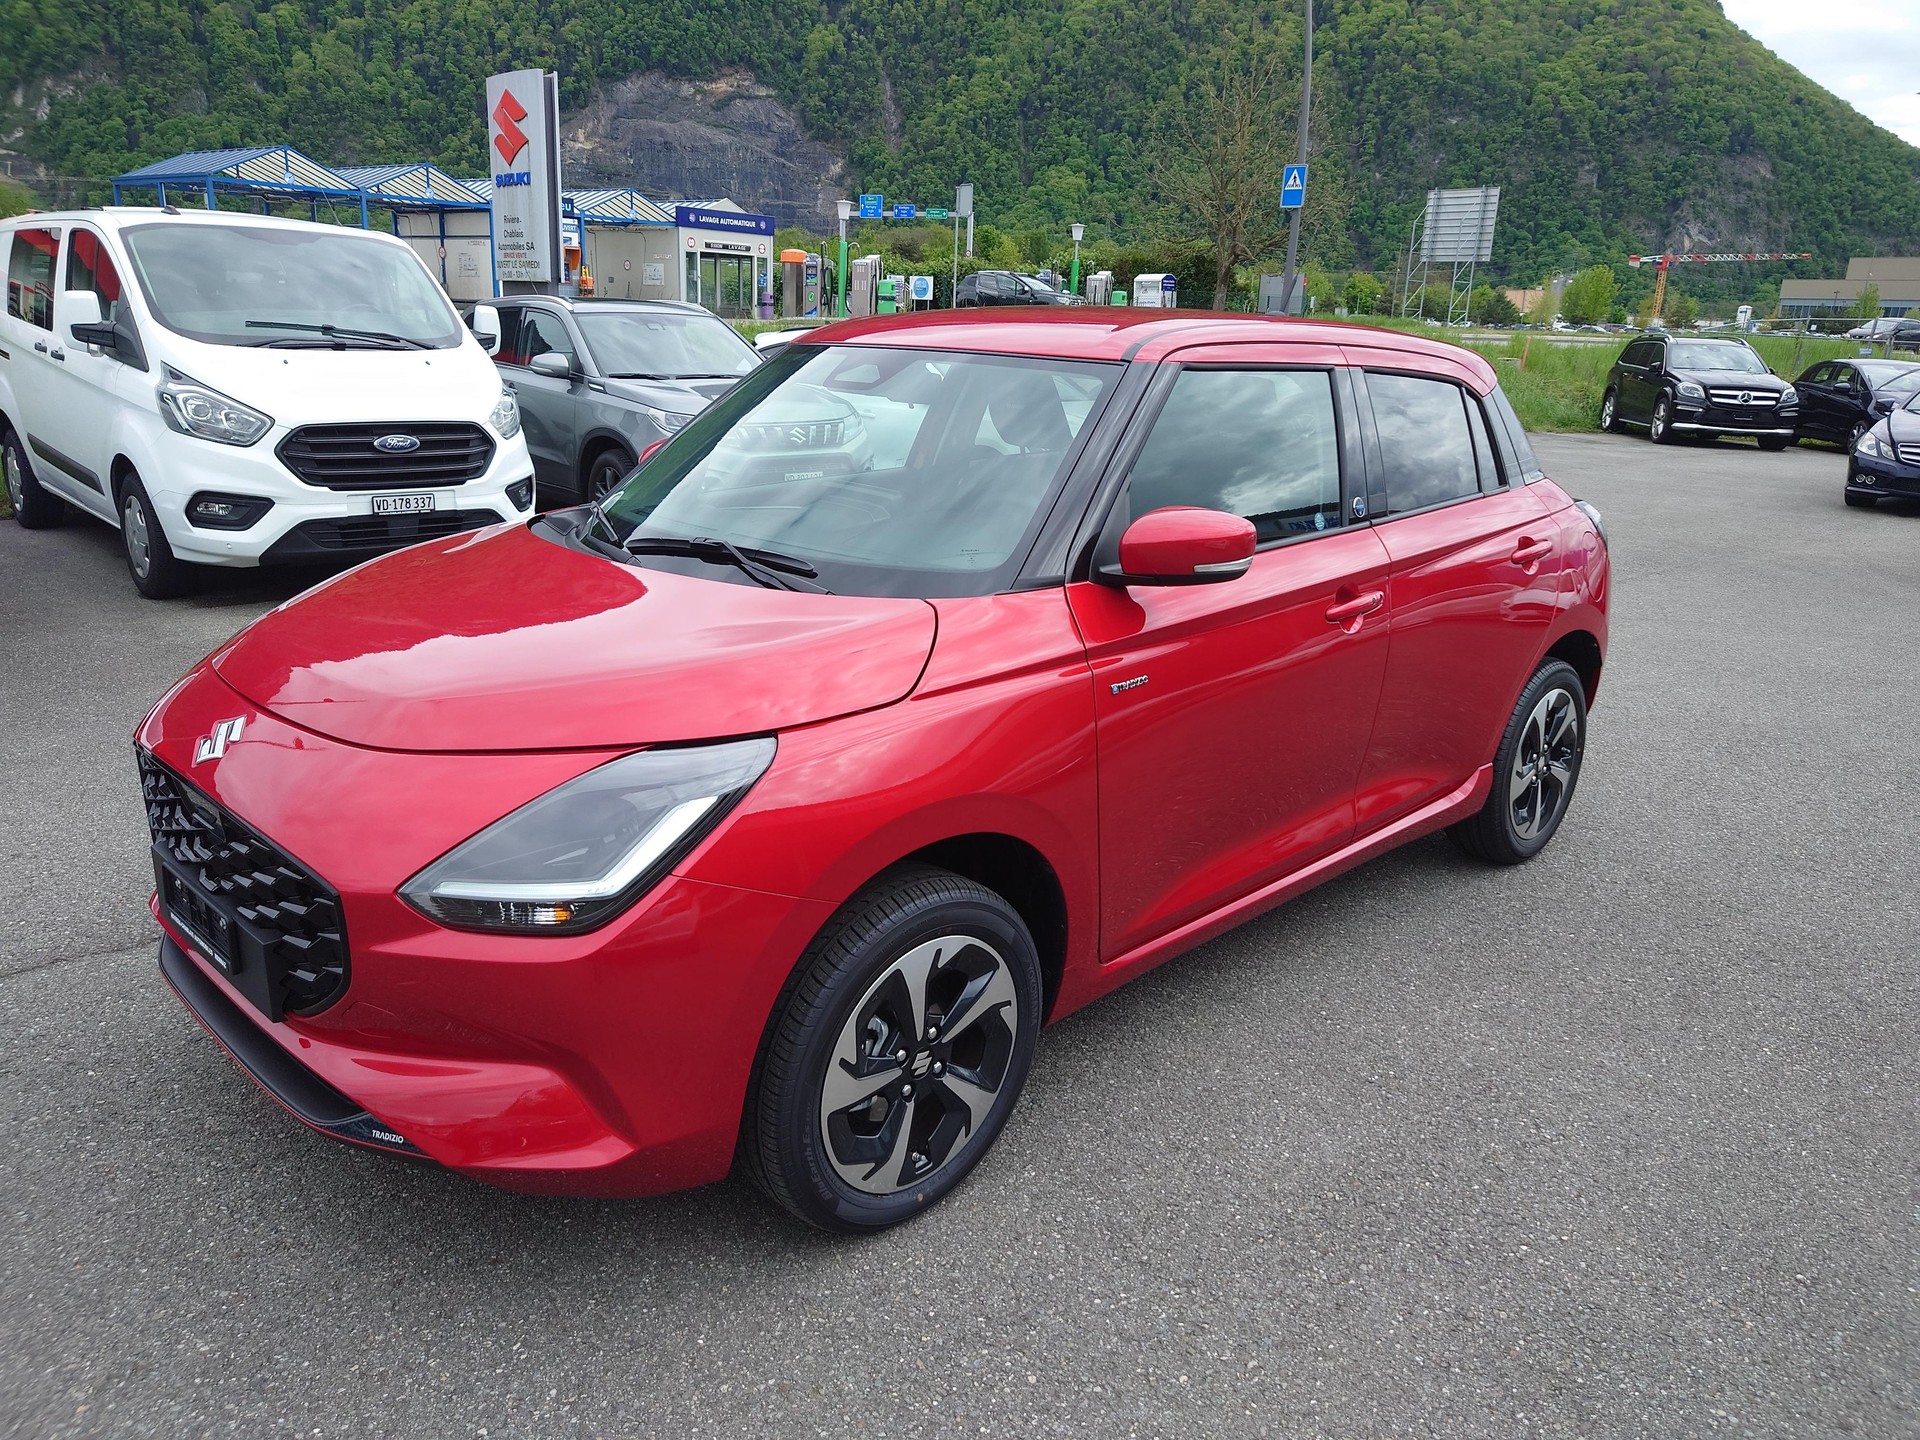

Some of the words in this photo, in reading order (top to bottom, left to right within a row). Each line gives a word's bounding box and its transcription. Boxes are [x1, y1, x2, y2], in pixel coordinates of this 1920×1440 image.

[495, 172, 531, 187] SUZUKI
[699, 215, 720, 225] LAVAGE
[720, 218, 756, 228] AUTOMATIQUE
[503, 228, 524, 238] Chablais
[498, 242, 525, 251] Automobiles
[525, 242, 535, 251] SA
[385, 437, 411, 448] Ford
[371, 1129, 404, 1144] TRADIZIO
